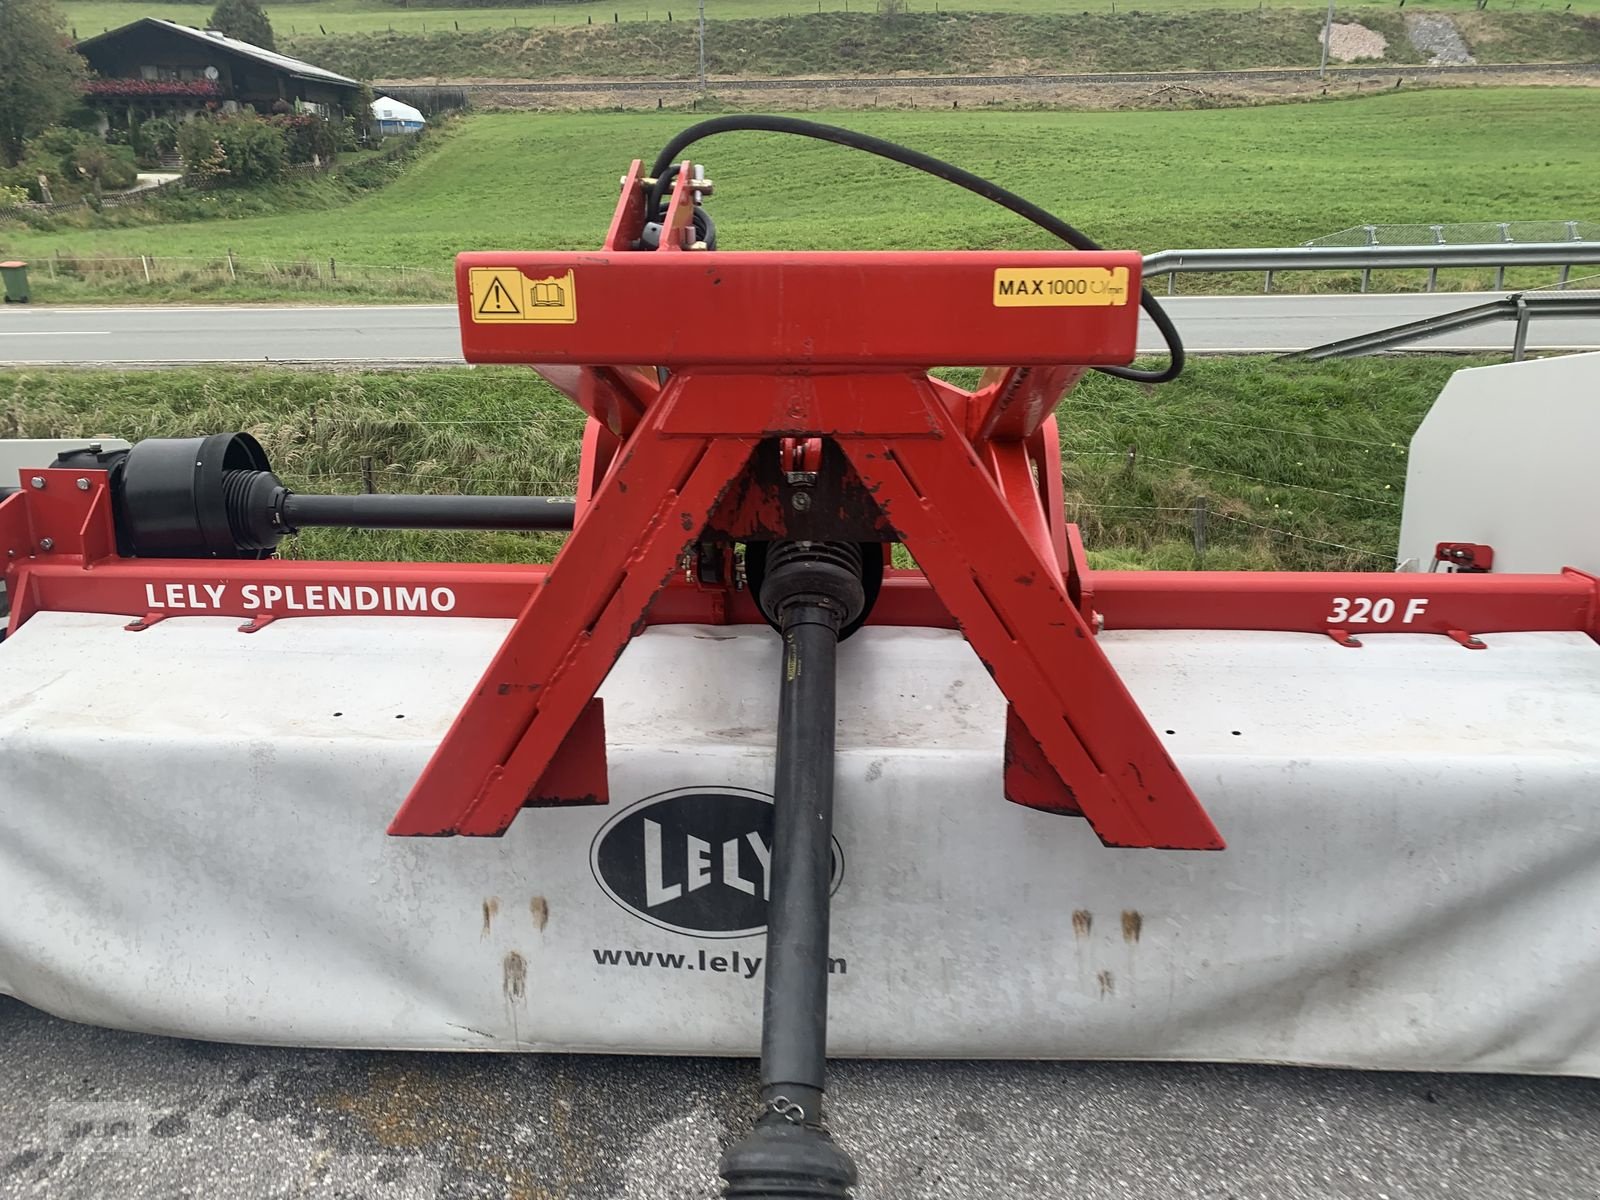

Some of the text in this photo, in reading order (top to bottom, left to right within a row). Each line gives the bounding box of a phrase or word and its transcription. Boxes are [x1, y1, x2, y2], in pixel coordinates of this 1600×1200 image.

[998, 280, 1044, 295] MAX
[145, 583, 456, 612] LELY SPLENDIMO
[1326, 597, 1430, 624] 320 F
[592, 948, 848, 979] www.lelym
